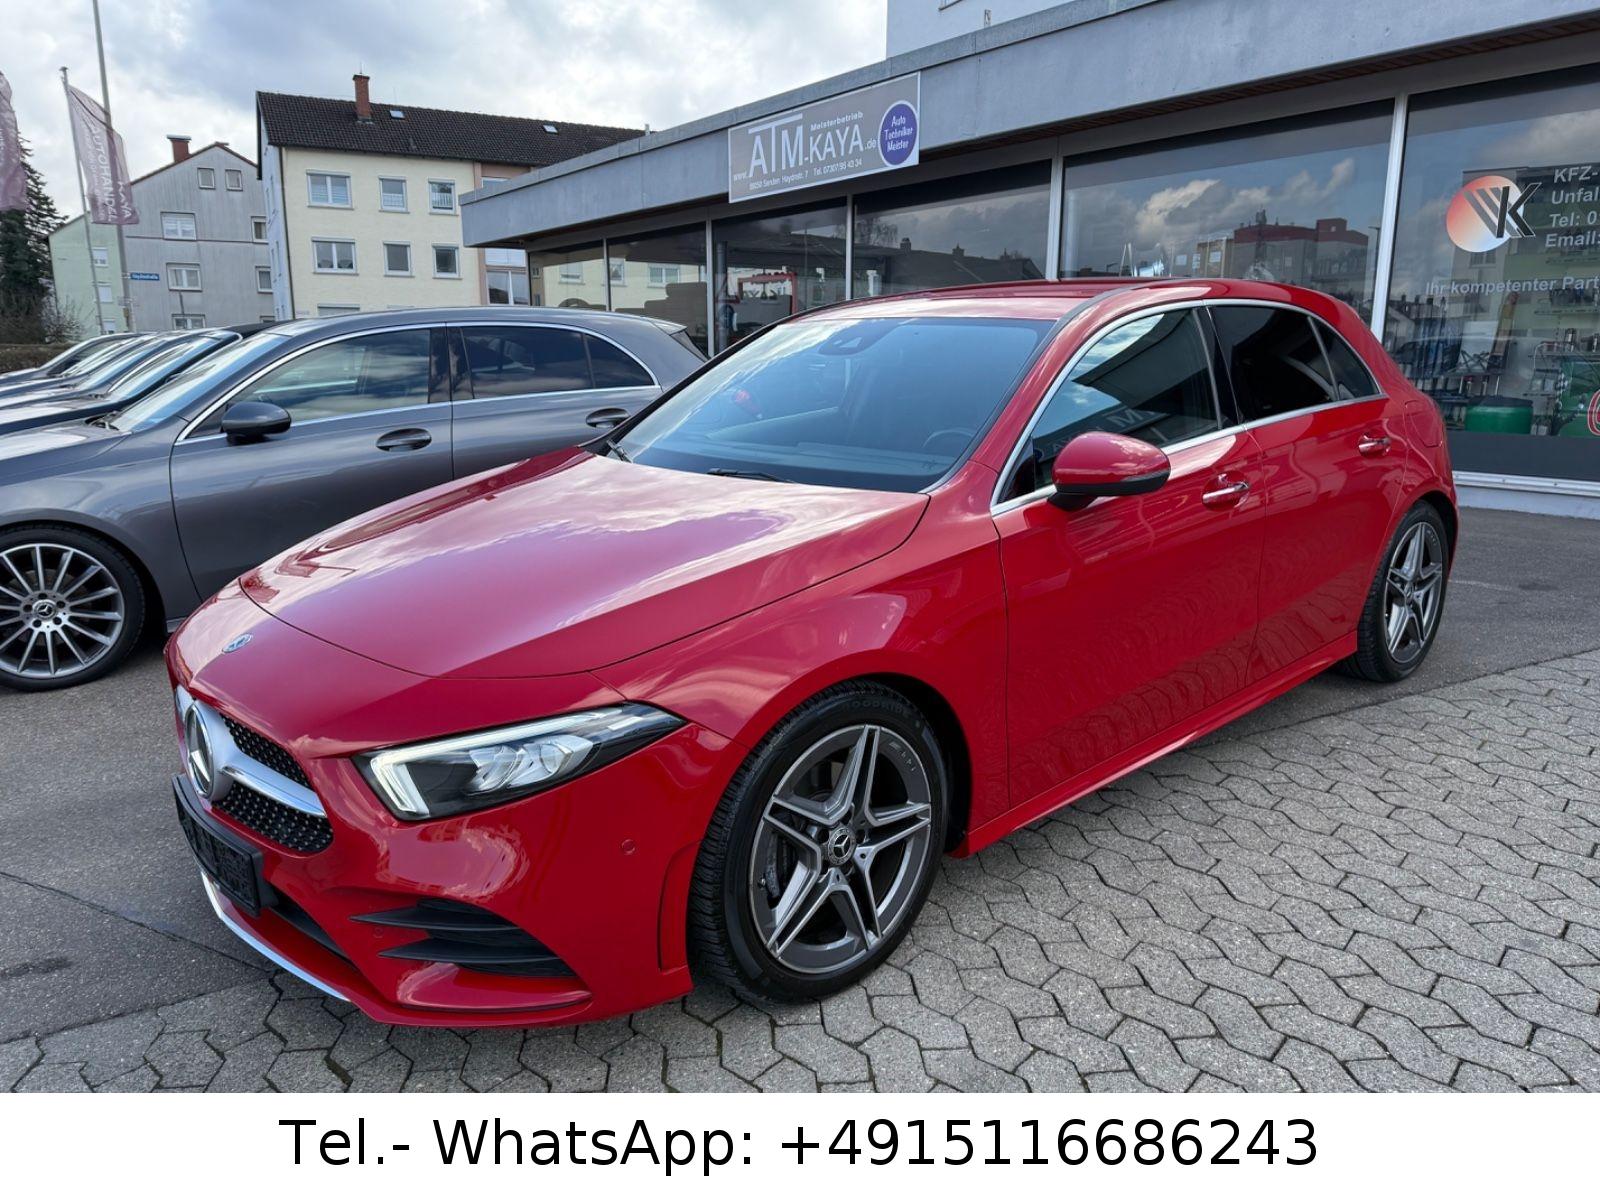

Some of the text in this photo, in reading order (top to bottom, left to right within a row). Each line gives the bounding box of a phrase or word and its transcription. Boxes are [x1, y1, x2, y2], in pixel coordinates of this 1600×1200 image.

[810, 111, 864, 132] Meisterbetrieb
[891, 115, 906, 128] Auto
[884, 127, 914, 141] Techniker
[887, 140, 909, 153] Meister
[93, 125, 118, 222] AUTOHANDEL
[1553, 166, 1598, 183] KFZ-
[1549, 211, 1600, 228] Tel: 0
[1545, 231, 1600, 248] Email:
[1425, 276, 1600, 295] Ihr kompetenter Part
